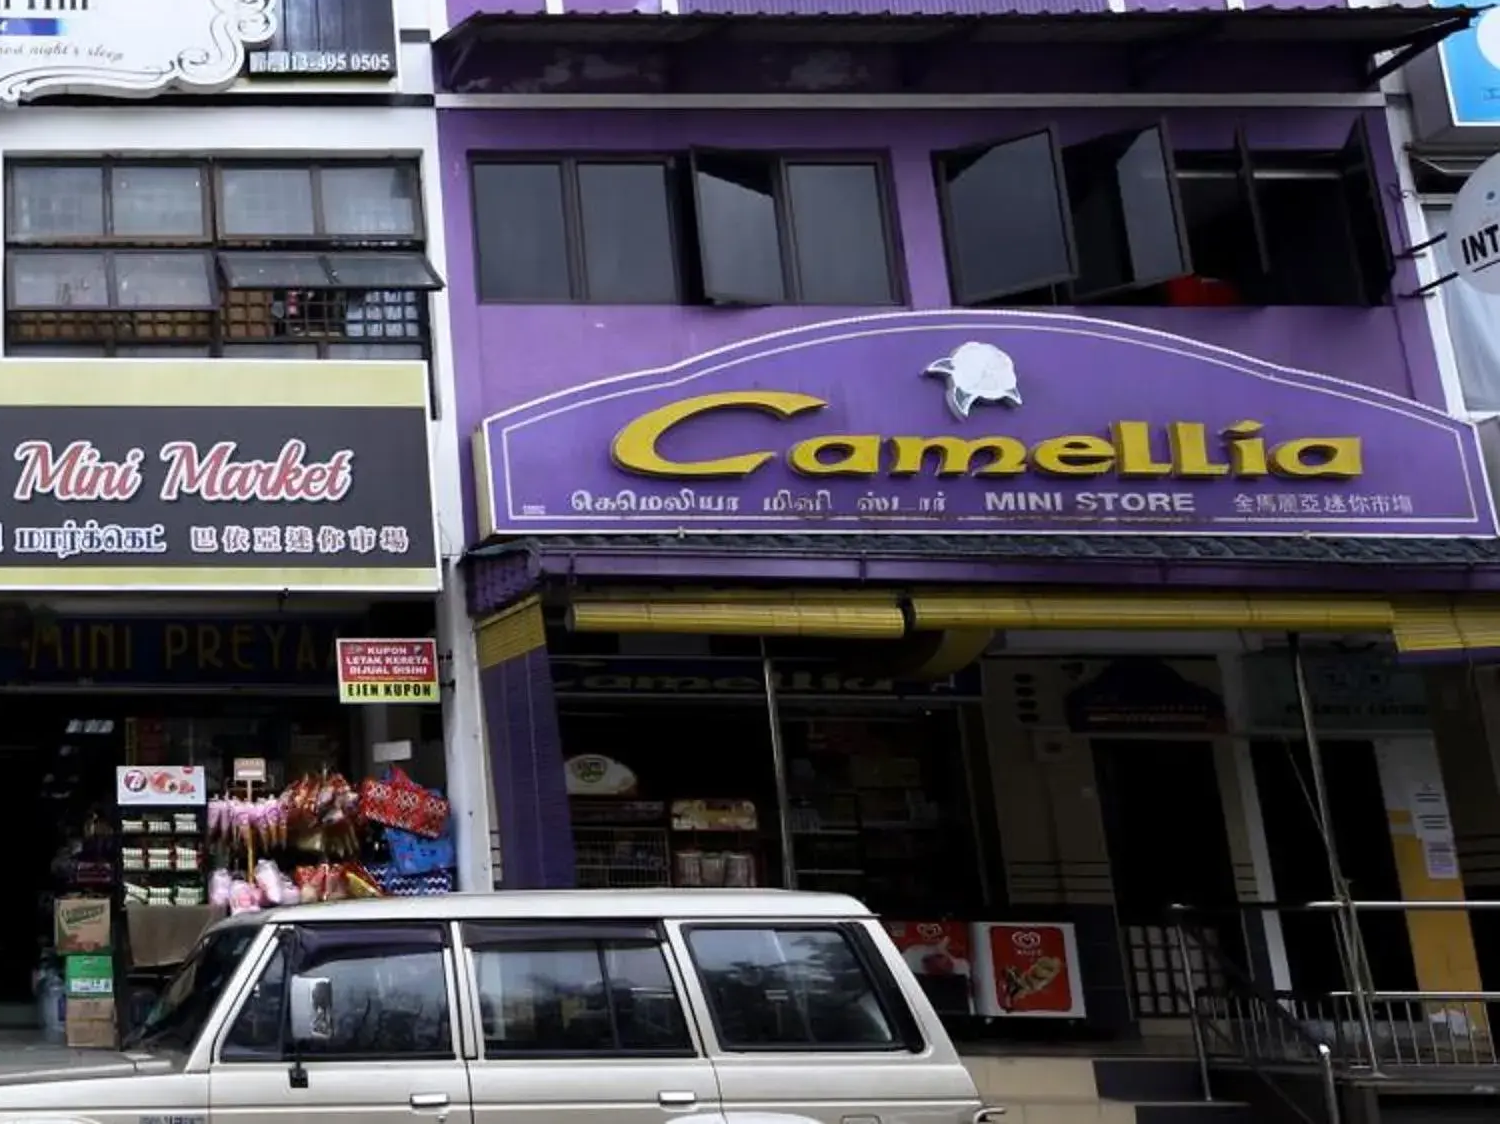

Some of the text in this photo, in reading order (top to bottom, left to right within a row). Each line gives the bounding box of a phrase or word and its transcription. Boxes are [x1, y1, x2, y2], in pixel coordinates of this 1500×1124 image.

[351, 53, 390, 71] 0505
[14, 439, 145, 501] Mini
[160, 438, 355, 501] Market
[984, 491, 1197, 512] MINI STORE
[28, 622, 133, 670] MINI
[384, 683, 431, 697] KUPON
